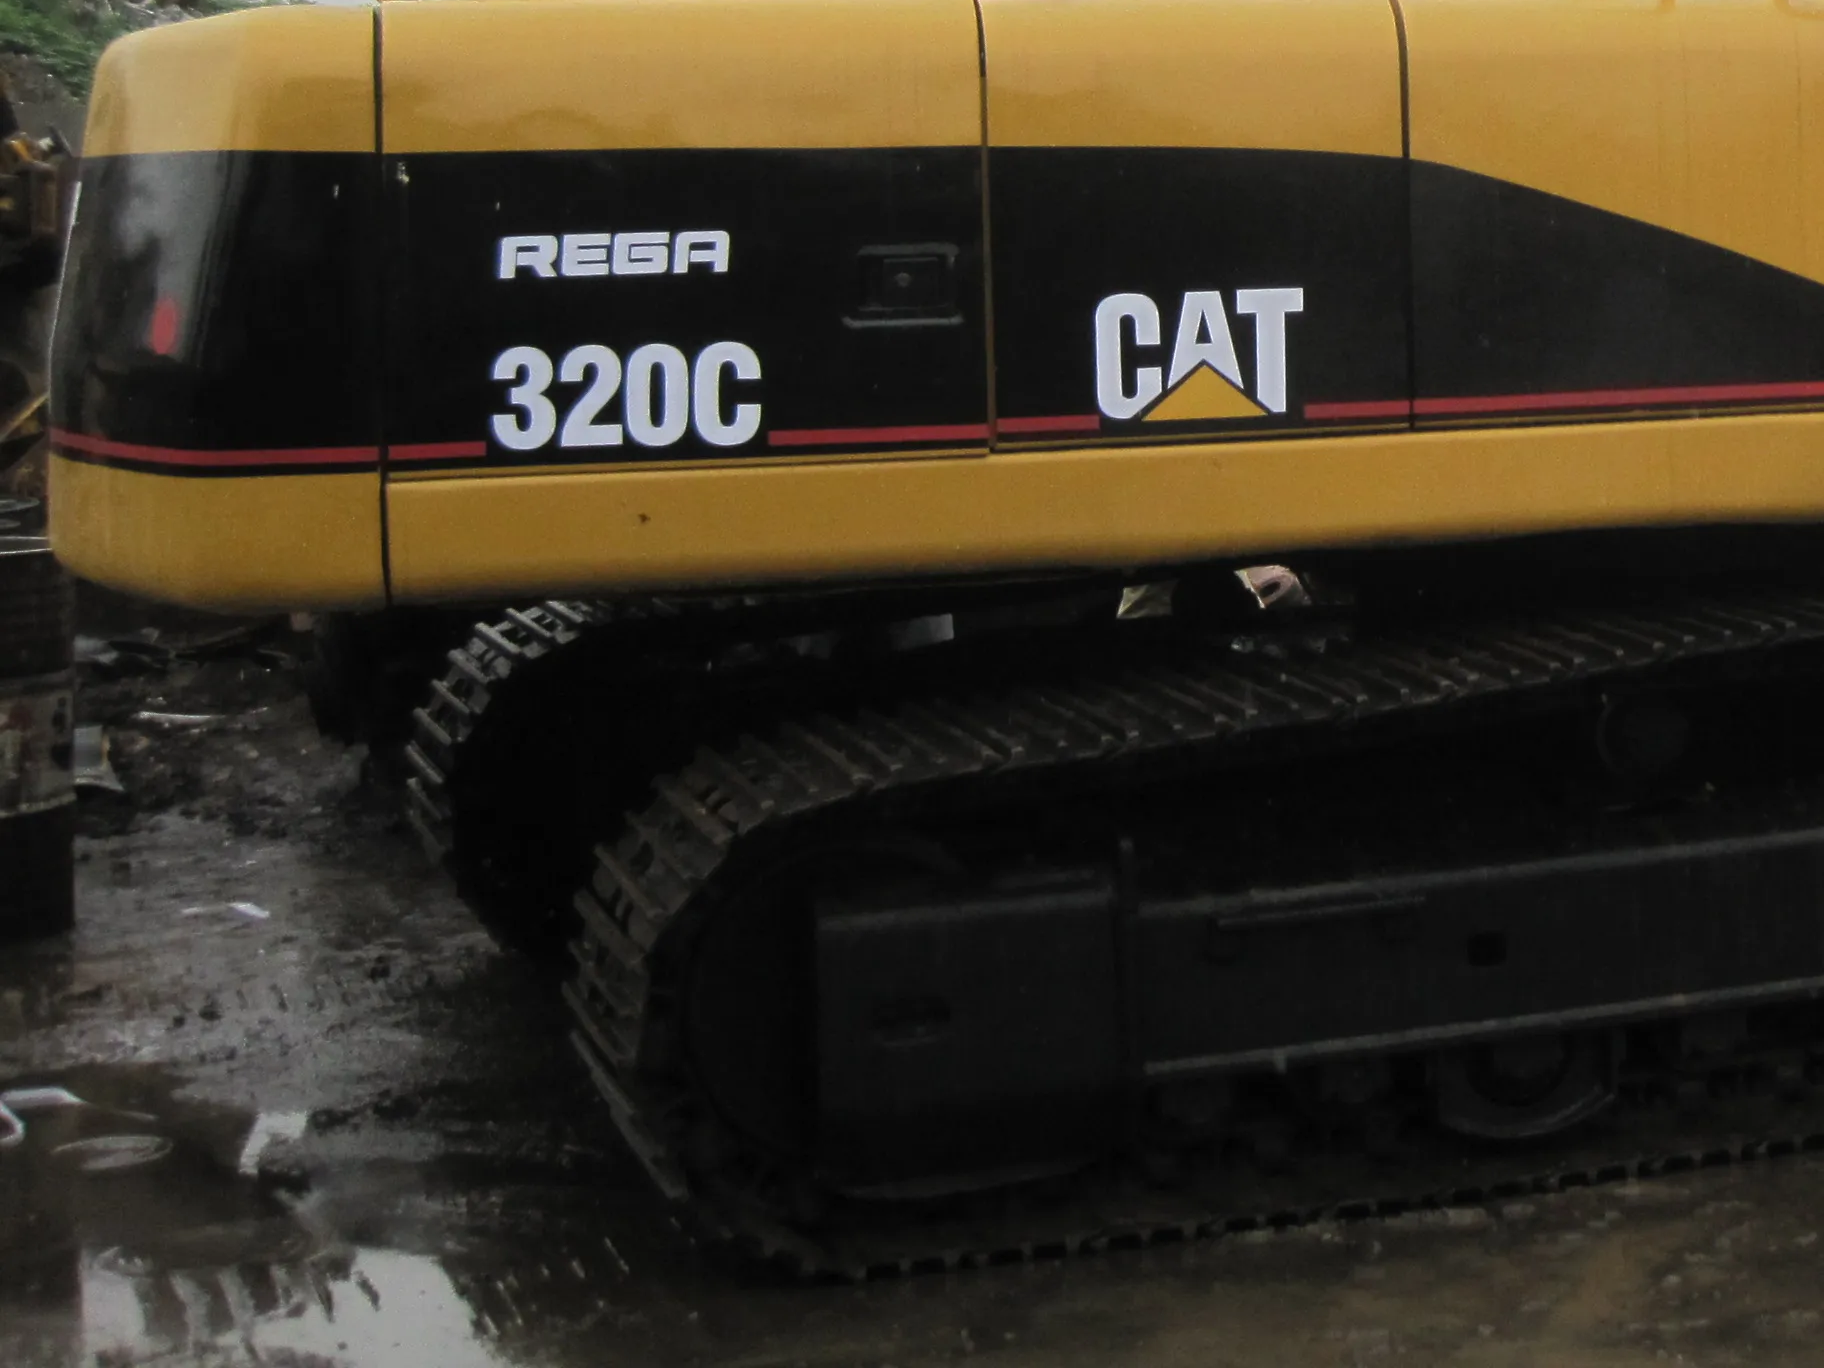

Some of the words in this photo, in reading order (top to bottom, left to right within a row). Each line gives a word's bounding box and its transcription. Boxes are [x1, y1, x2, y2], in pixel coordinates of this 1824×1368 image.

[499, 230, 730, 280] REGA
[490, 341, 762, 451] 320C
[1094, 287, 1304, 420] CAT
